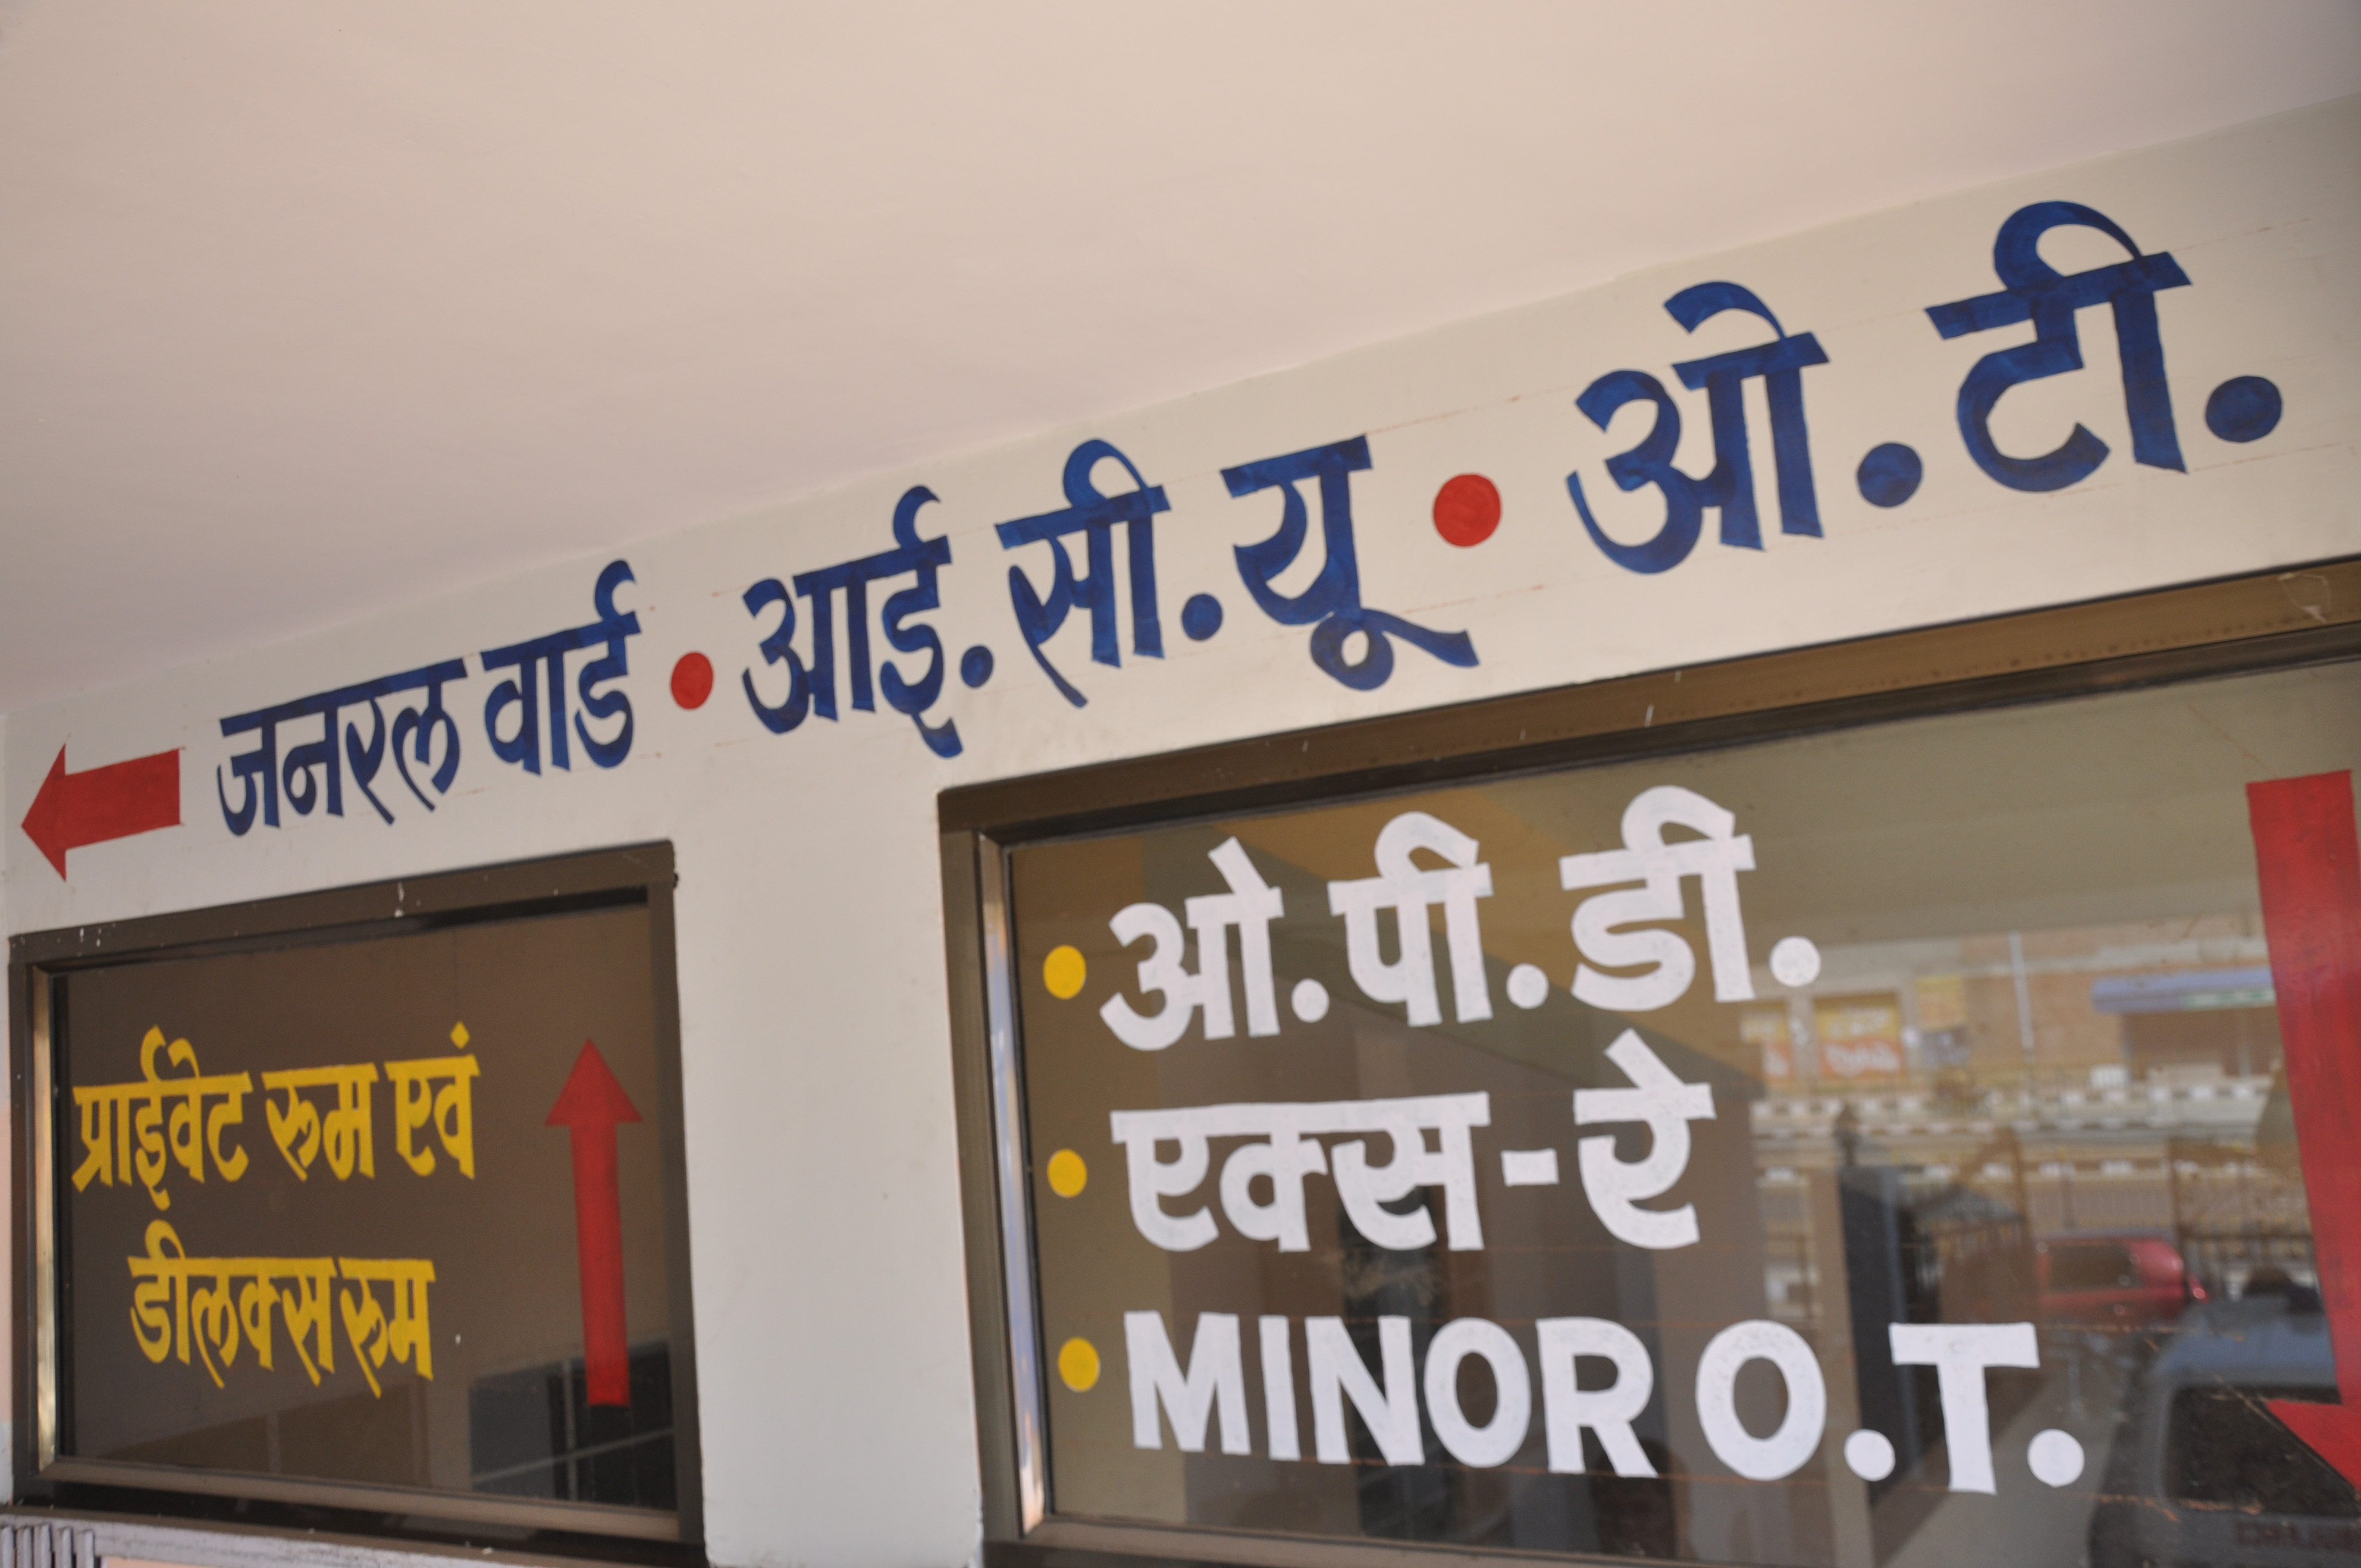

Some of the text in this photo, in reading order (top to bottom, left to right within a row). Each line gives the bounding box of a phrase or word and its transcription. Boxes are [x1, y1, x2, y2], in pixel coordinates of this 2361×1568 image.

[216, 657, 468, 836] जनरल
[480, 559, 641, 777] वार्ड
[72, 1025, 254, 1211] प्राईवेट
[384, 1021, 481, 1179] एवं
[128, 1219, 337, 1389] डीलक्स
[1124, 1310, 2085, 1494] MINOR O.T.
